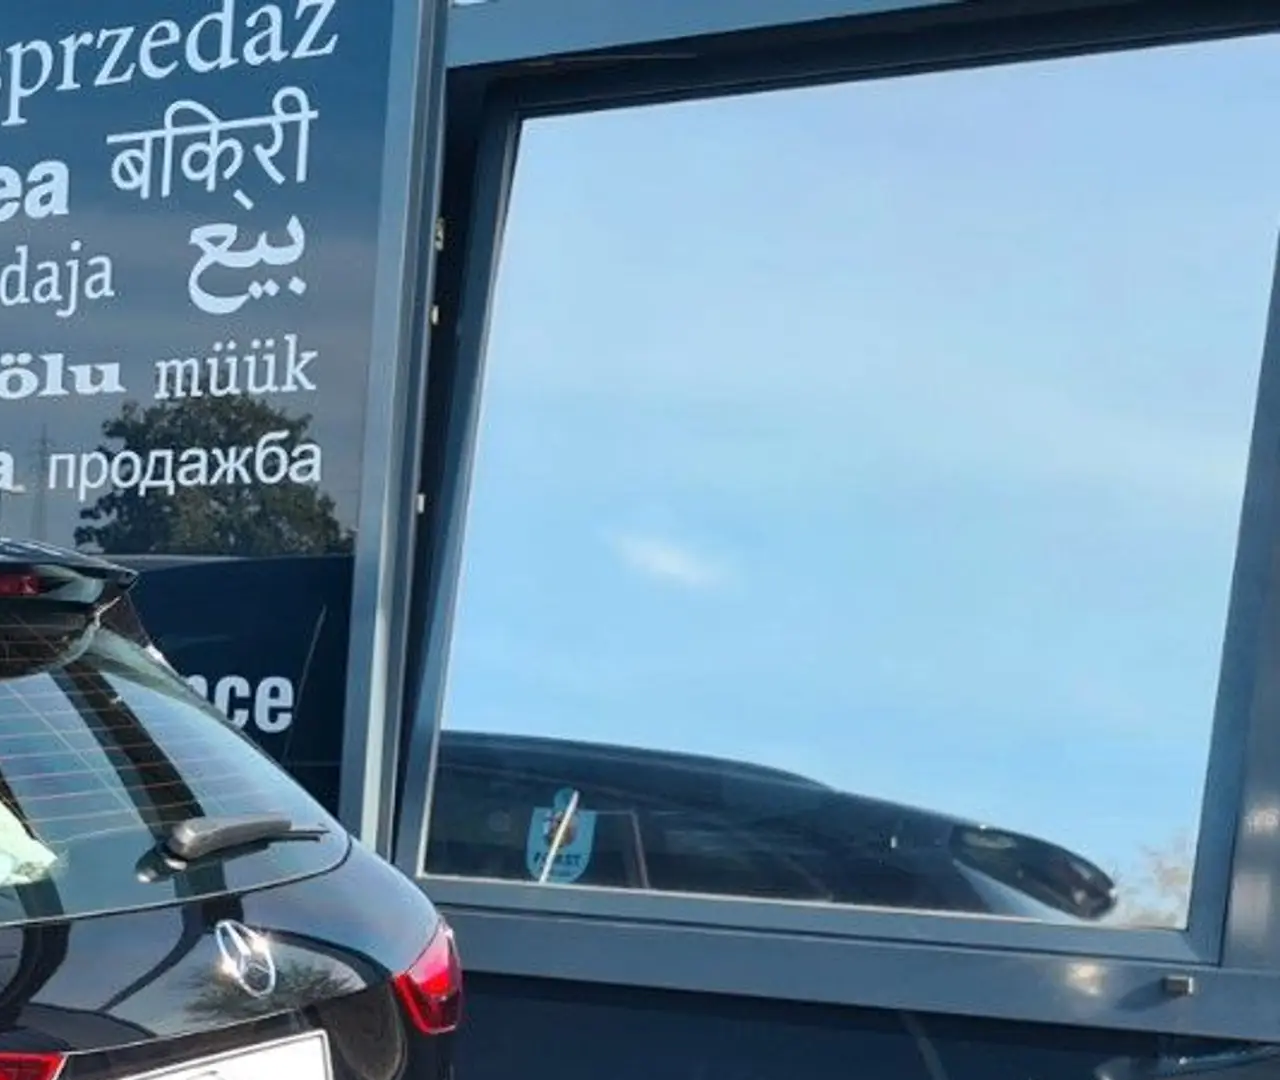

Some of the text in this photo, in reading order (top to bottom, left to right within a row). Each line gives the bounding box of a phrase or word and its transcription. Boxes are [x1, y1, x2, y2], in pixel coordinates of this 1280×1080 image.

[188, 214, 307, 315] بيع
[153, 333, 318, 400] müük
[47, 431, 322, 503] продажба
